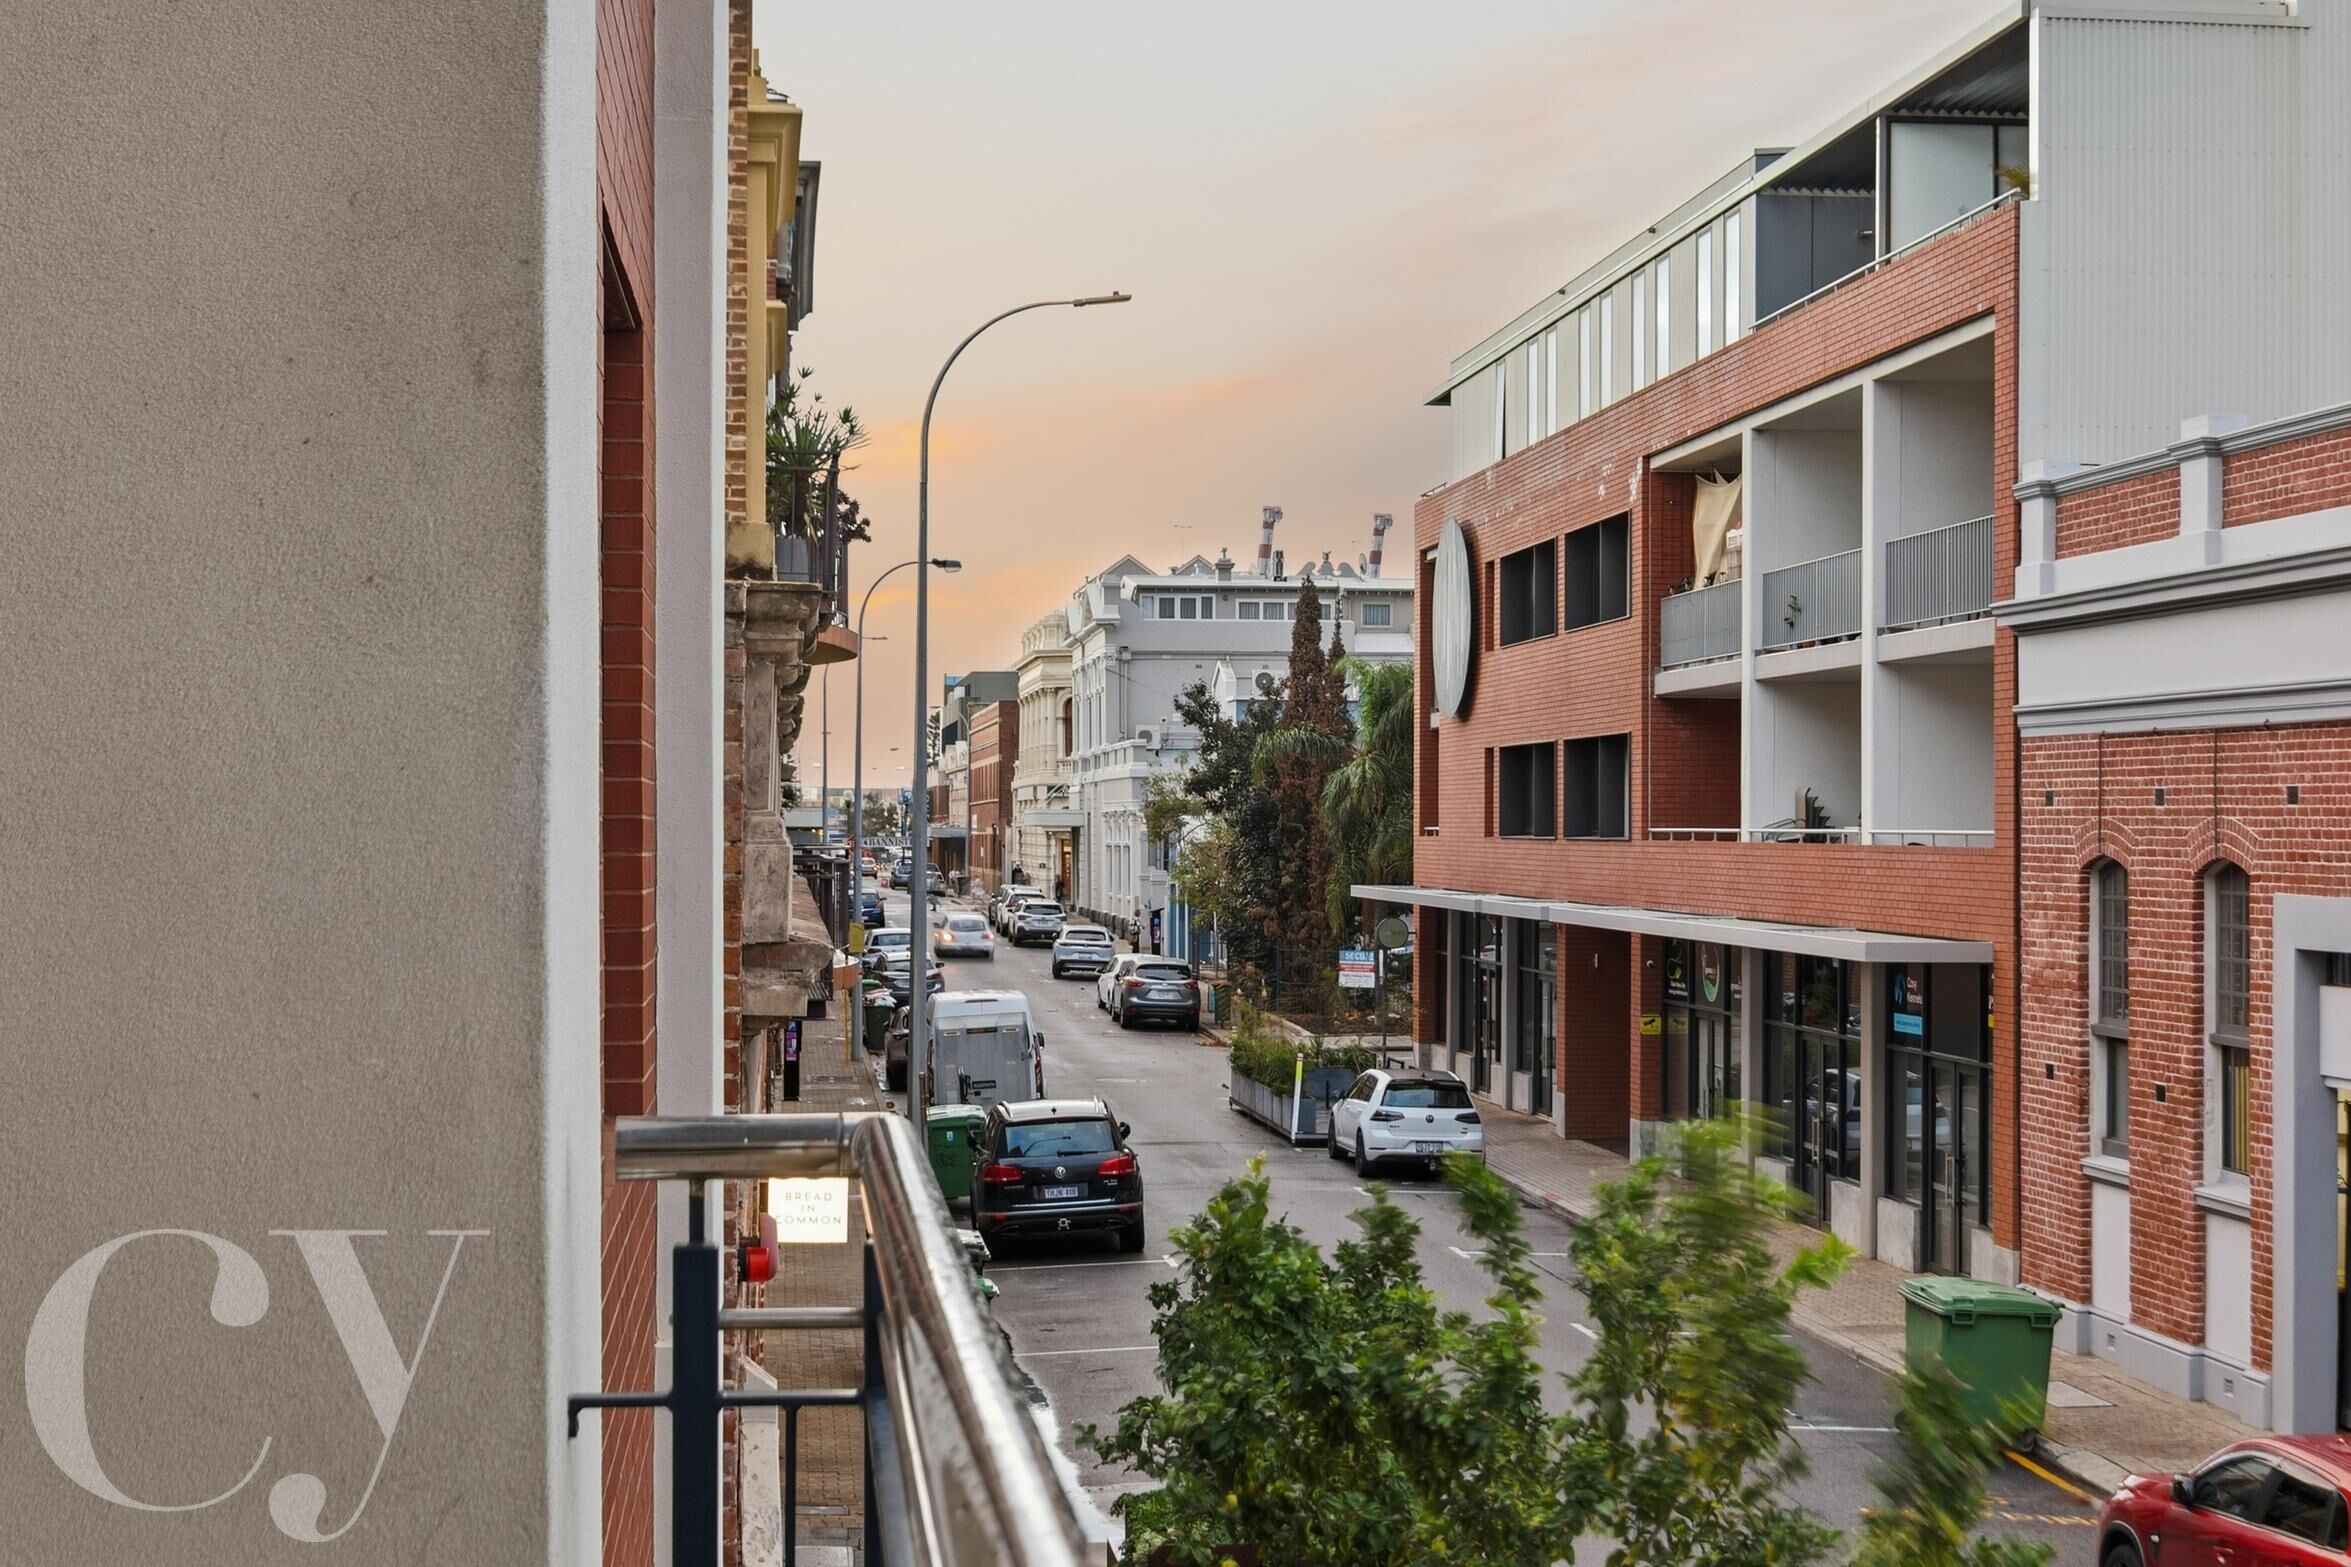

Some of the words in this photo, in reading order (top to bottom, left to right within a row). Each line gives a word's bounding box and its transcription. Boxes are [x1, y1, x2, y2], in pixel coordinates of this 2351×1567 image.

[785, 1192, 832, 1201] BREAD
[801, 1204, 815, 1213] IN
[776, 1216, 841, 1225] COMMON
